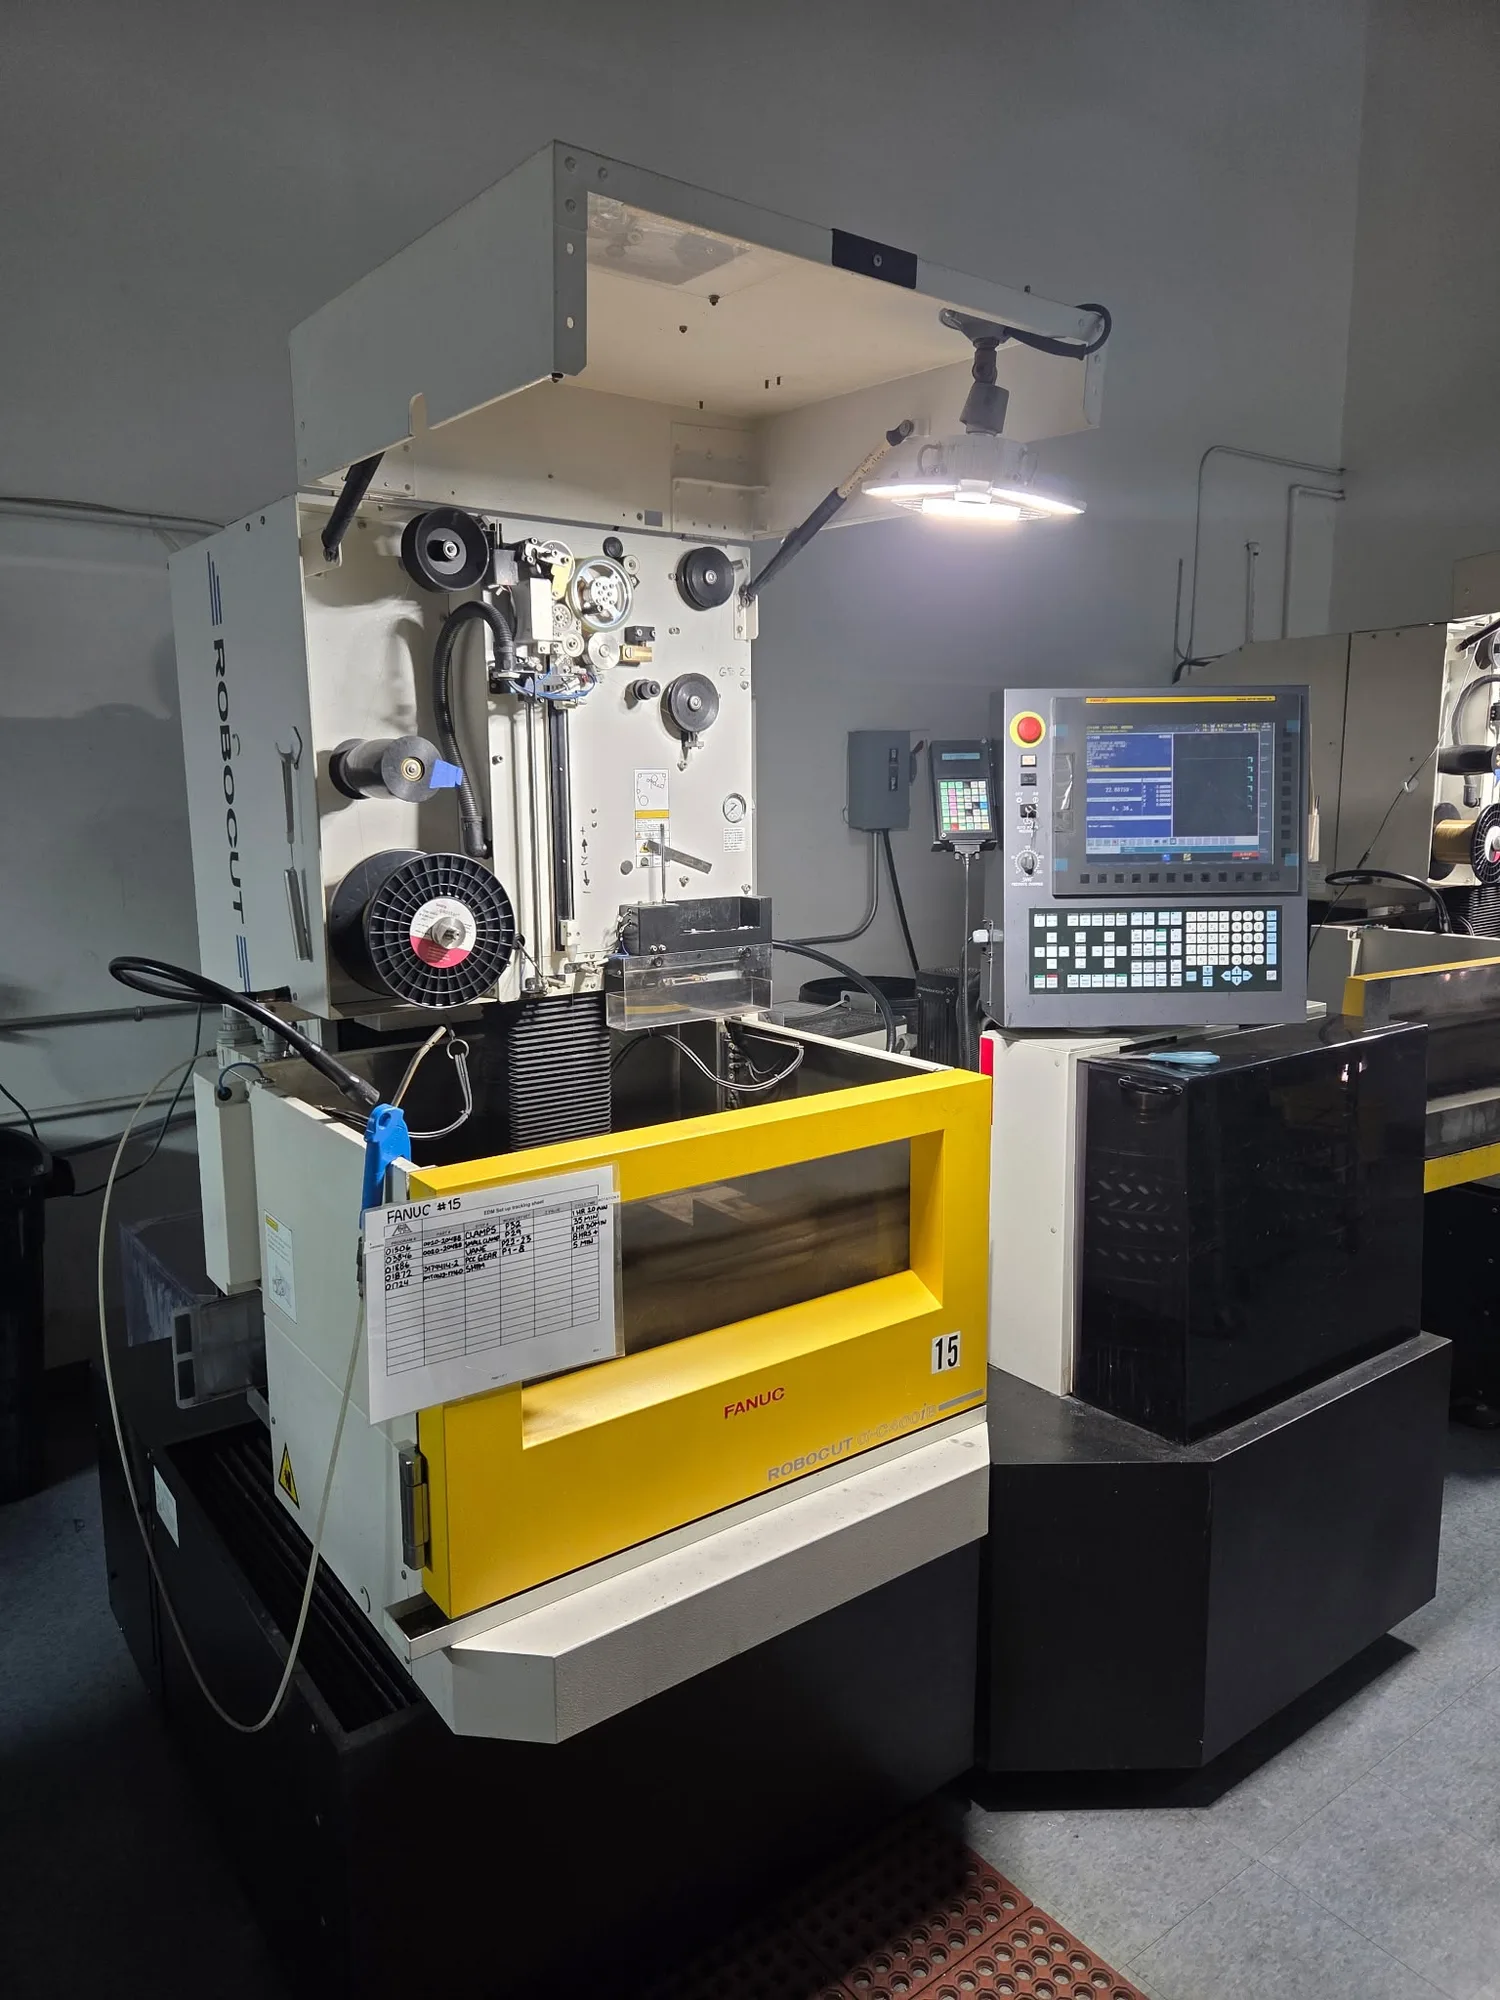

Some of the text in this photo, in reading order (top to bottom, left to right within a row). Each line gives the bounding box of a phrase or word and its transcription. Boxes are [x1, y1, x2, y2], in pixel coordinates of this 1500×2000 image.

[213, 638, 245, 925] ROBOCUT
[387, 1198, 462, 1224] FANUC #15
[512, 1202, 531, 1210] tracking
[505, 1220, 521, 1230] P32
[574, 1213, 598, 1226] 35 MIN
[466, 1225, 497, 1240] CLAMPS
[505, 1229, 522, 1238] P29
[576, 1224, 585, 1232] HR
[502, 1235, 532, 1248] P22-23
[573, 1232, 578, 1241] 8
[579, 1230, 592, 1239] HRS
[573, 1237, 593, 1249] 5 MIN
[478, 1251, 498, 1262] GEAR
[934, 1334, 959, 1370] 15
[723, 1387, 785, 1420] FANUC
[767, 1437, 853, 1482] ROBOCUT
